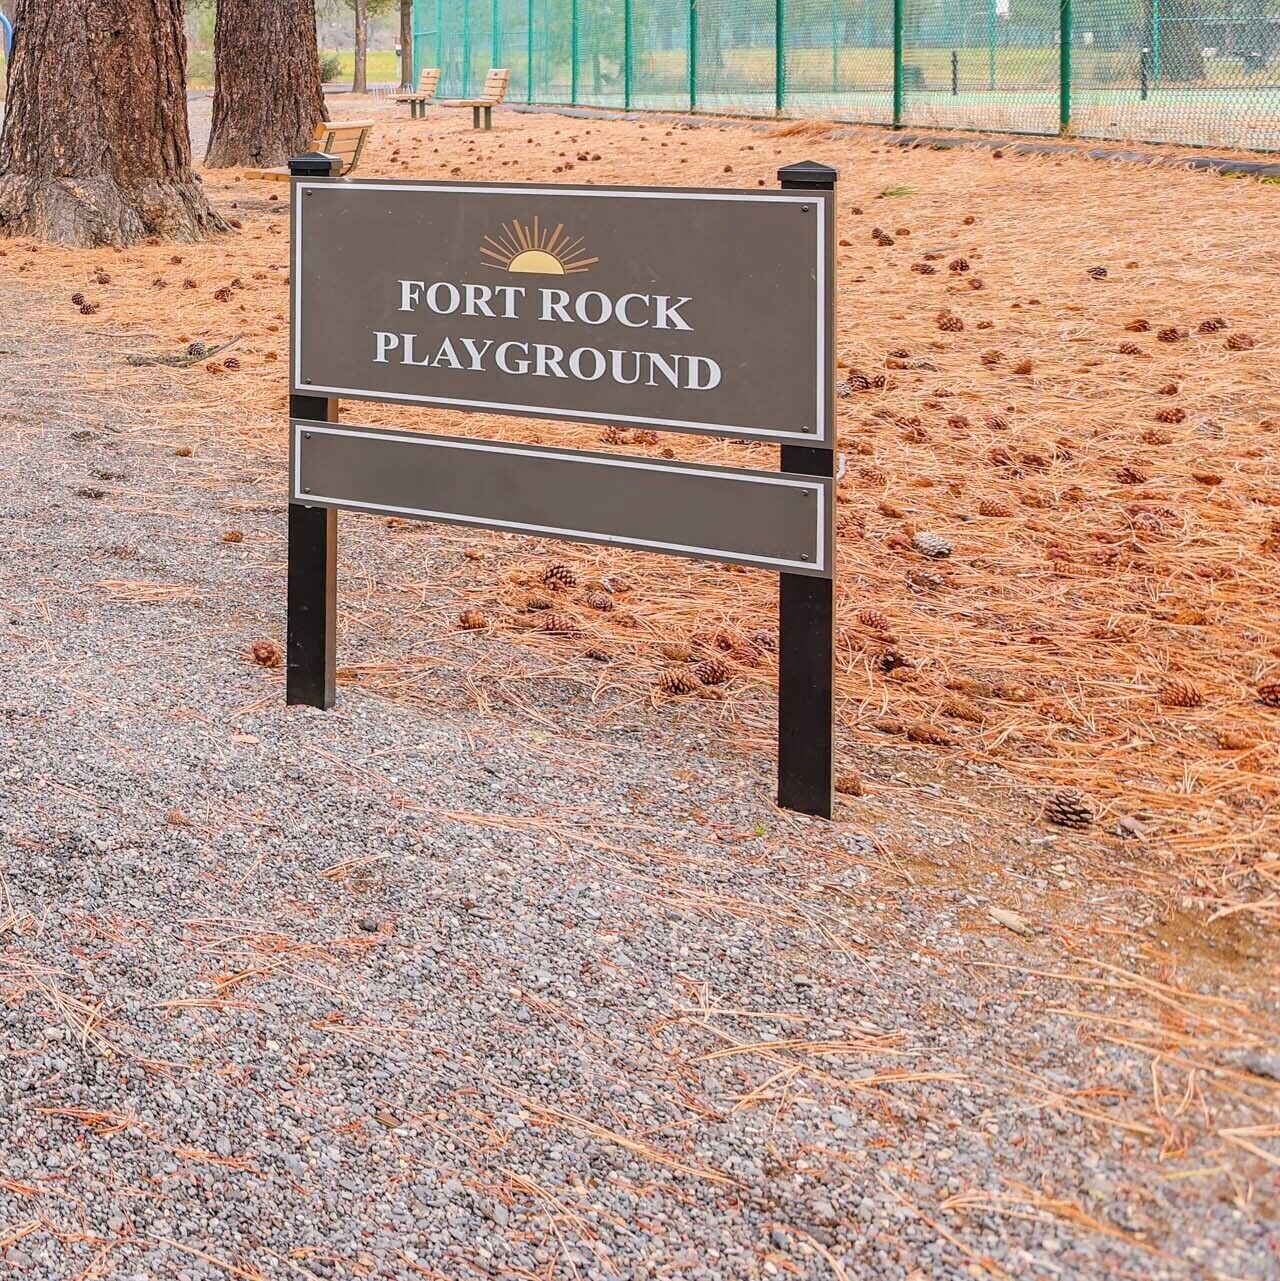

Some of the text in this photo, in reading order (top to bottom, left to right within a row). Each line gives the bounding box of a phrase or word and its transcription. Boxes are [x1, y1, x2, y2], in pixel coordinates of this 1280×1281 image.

[397, 279, 695, 331] FORT ROCK
[372, 331, 723, 391] PLAYGROUND
